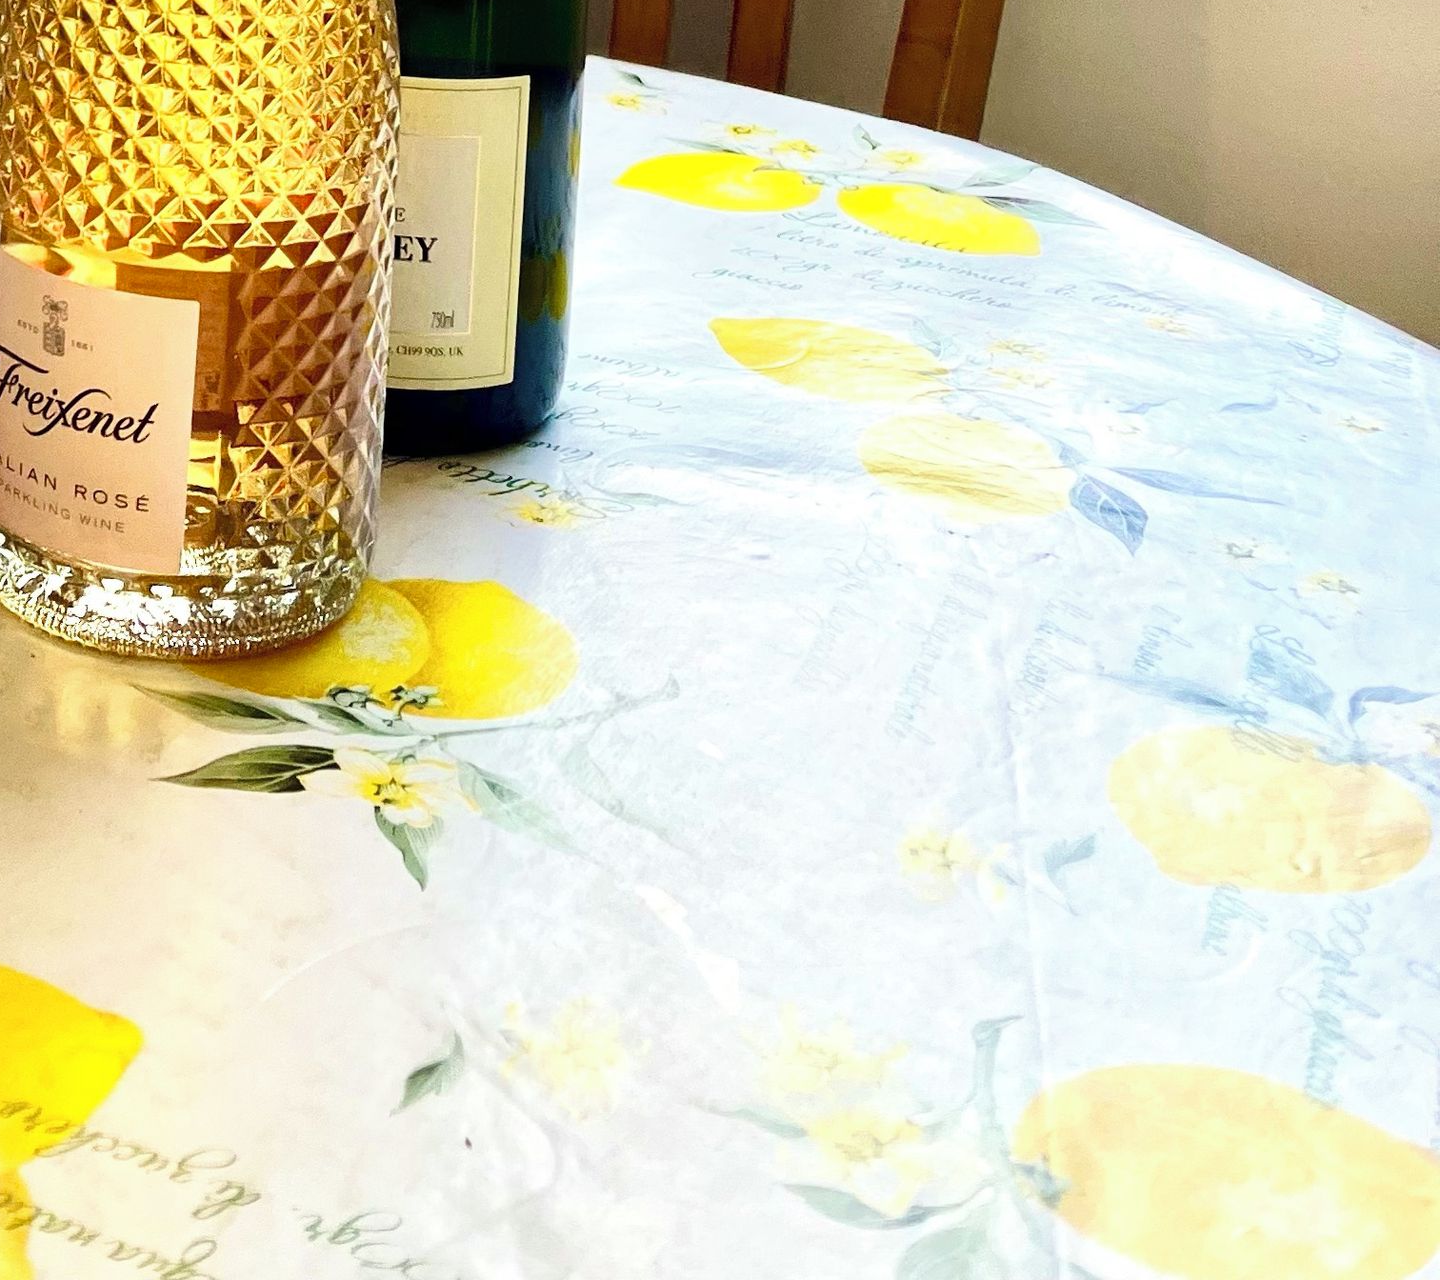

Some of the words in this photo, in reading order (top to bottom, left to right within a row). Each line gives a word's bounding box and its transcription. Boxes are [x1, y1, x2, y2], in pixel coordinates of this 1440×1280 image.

[448, 347, 465, 357] UK
[73, 482, 151, 513] ROSÉ
[78, 512, 126, 534] WINE
